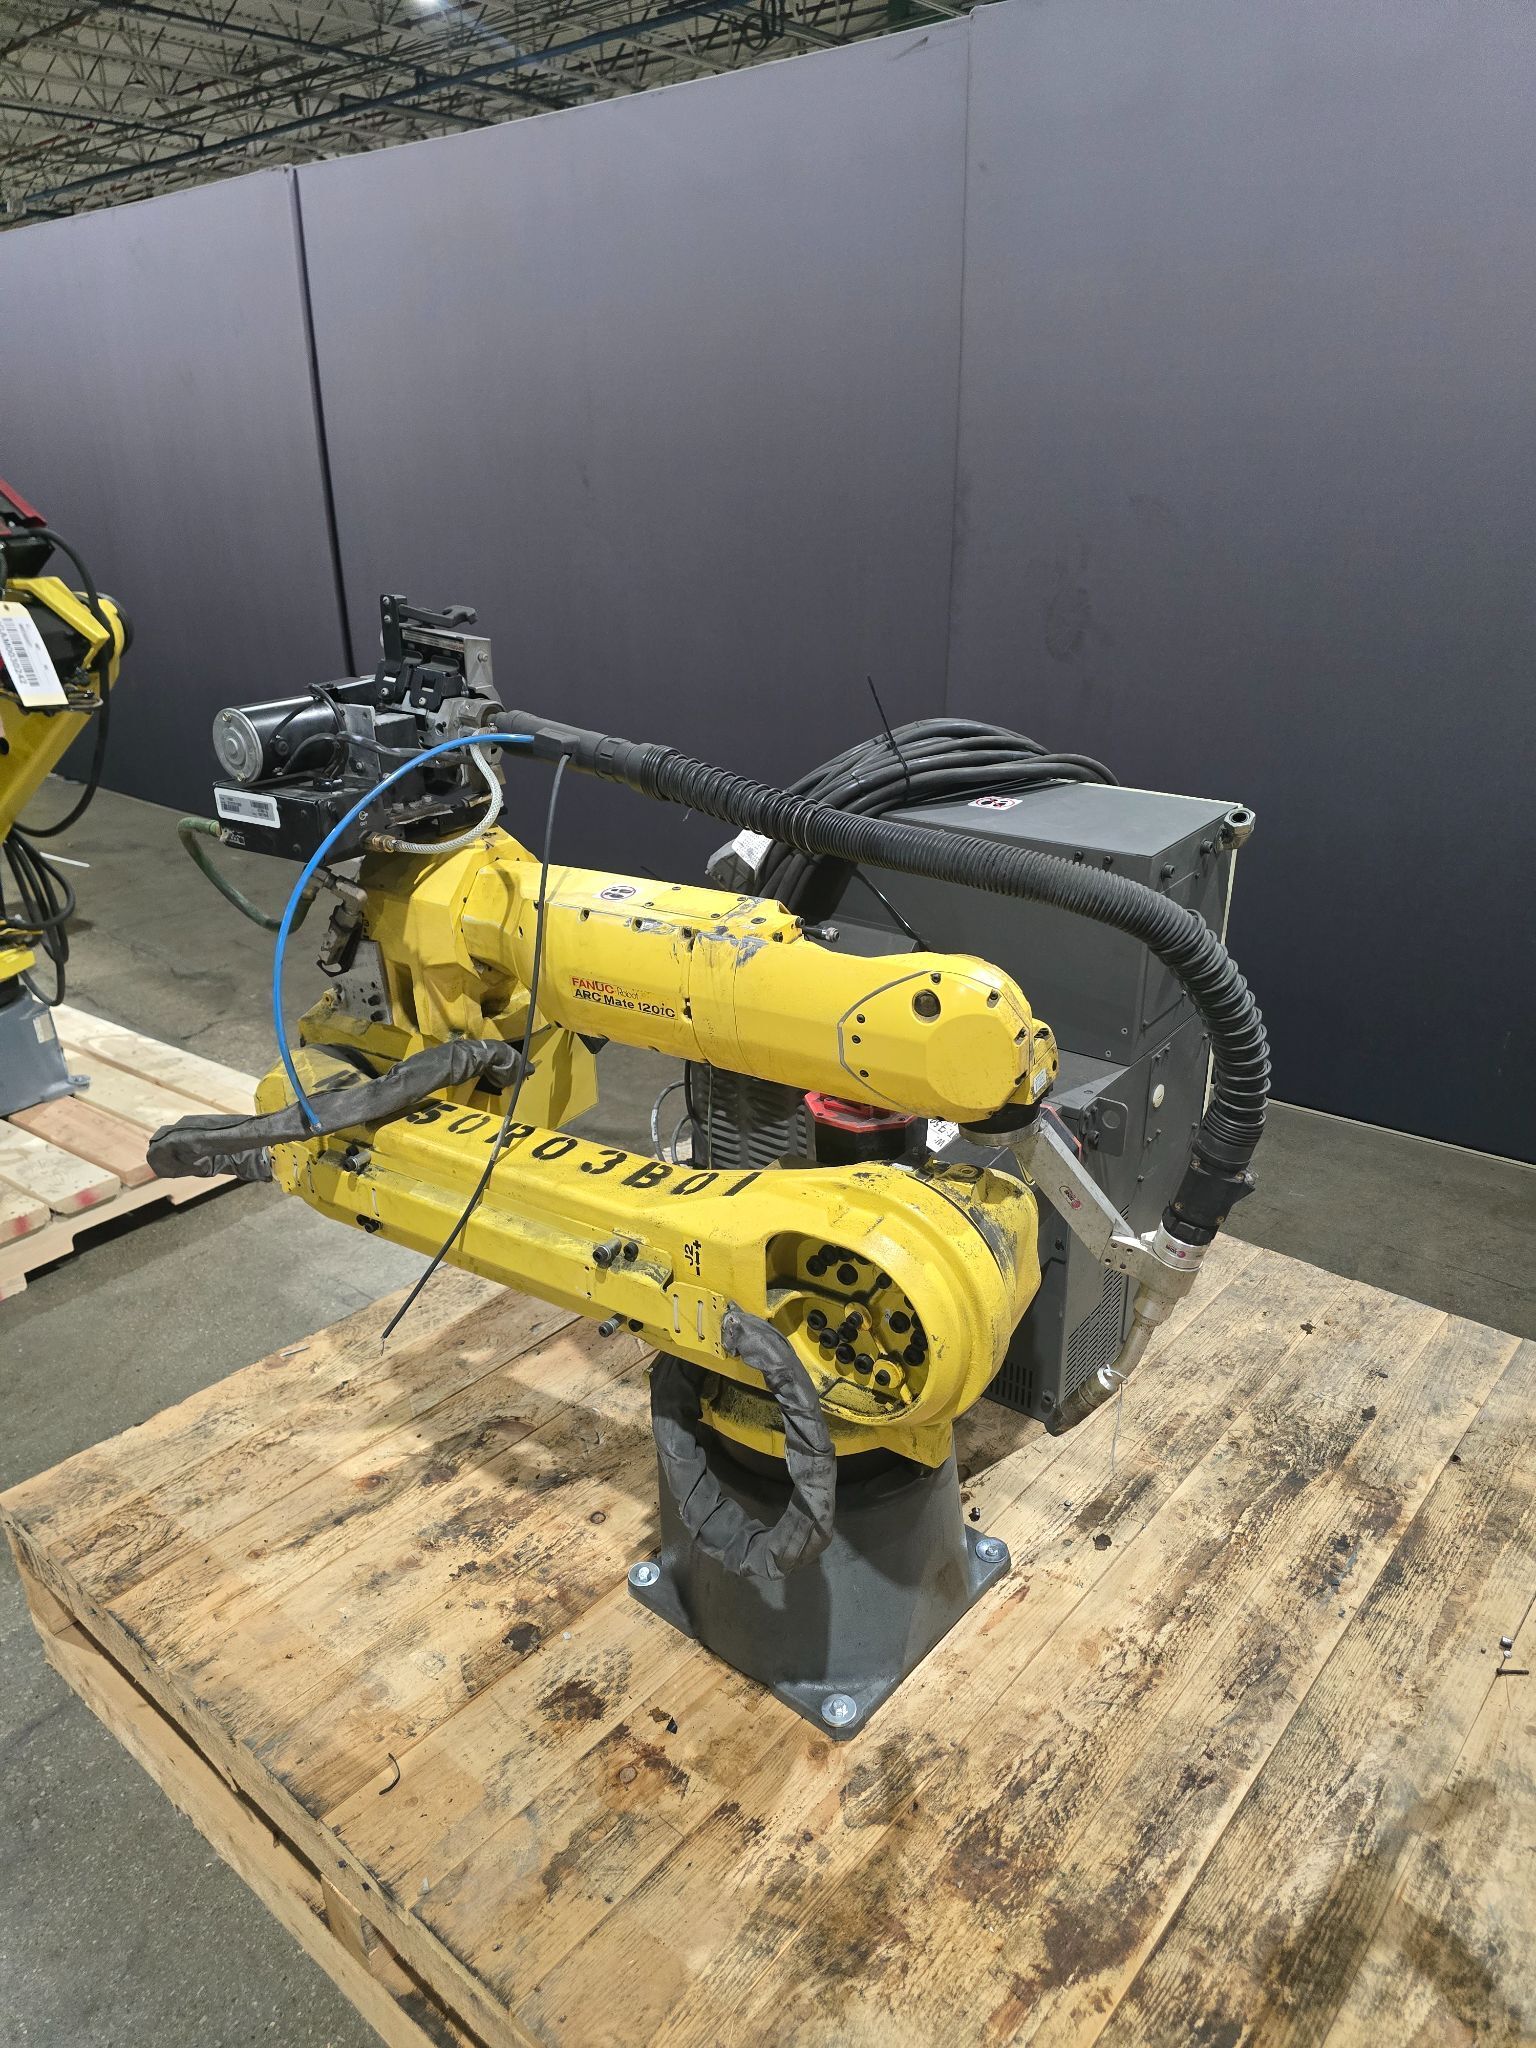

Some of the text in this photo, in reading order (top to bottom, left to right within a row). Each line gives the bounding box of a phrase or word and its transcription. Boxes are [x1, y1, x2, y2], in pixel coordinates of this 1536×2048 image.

[571, 976, 615, 995] FANUC
[574, 988, 676, 1018] ARC Mate 120iC
[684, 1243, 694, 1266] J2
